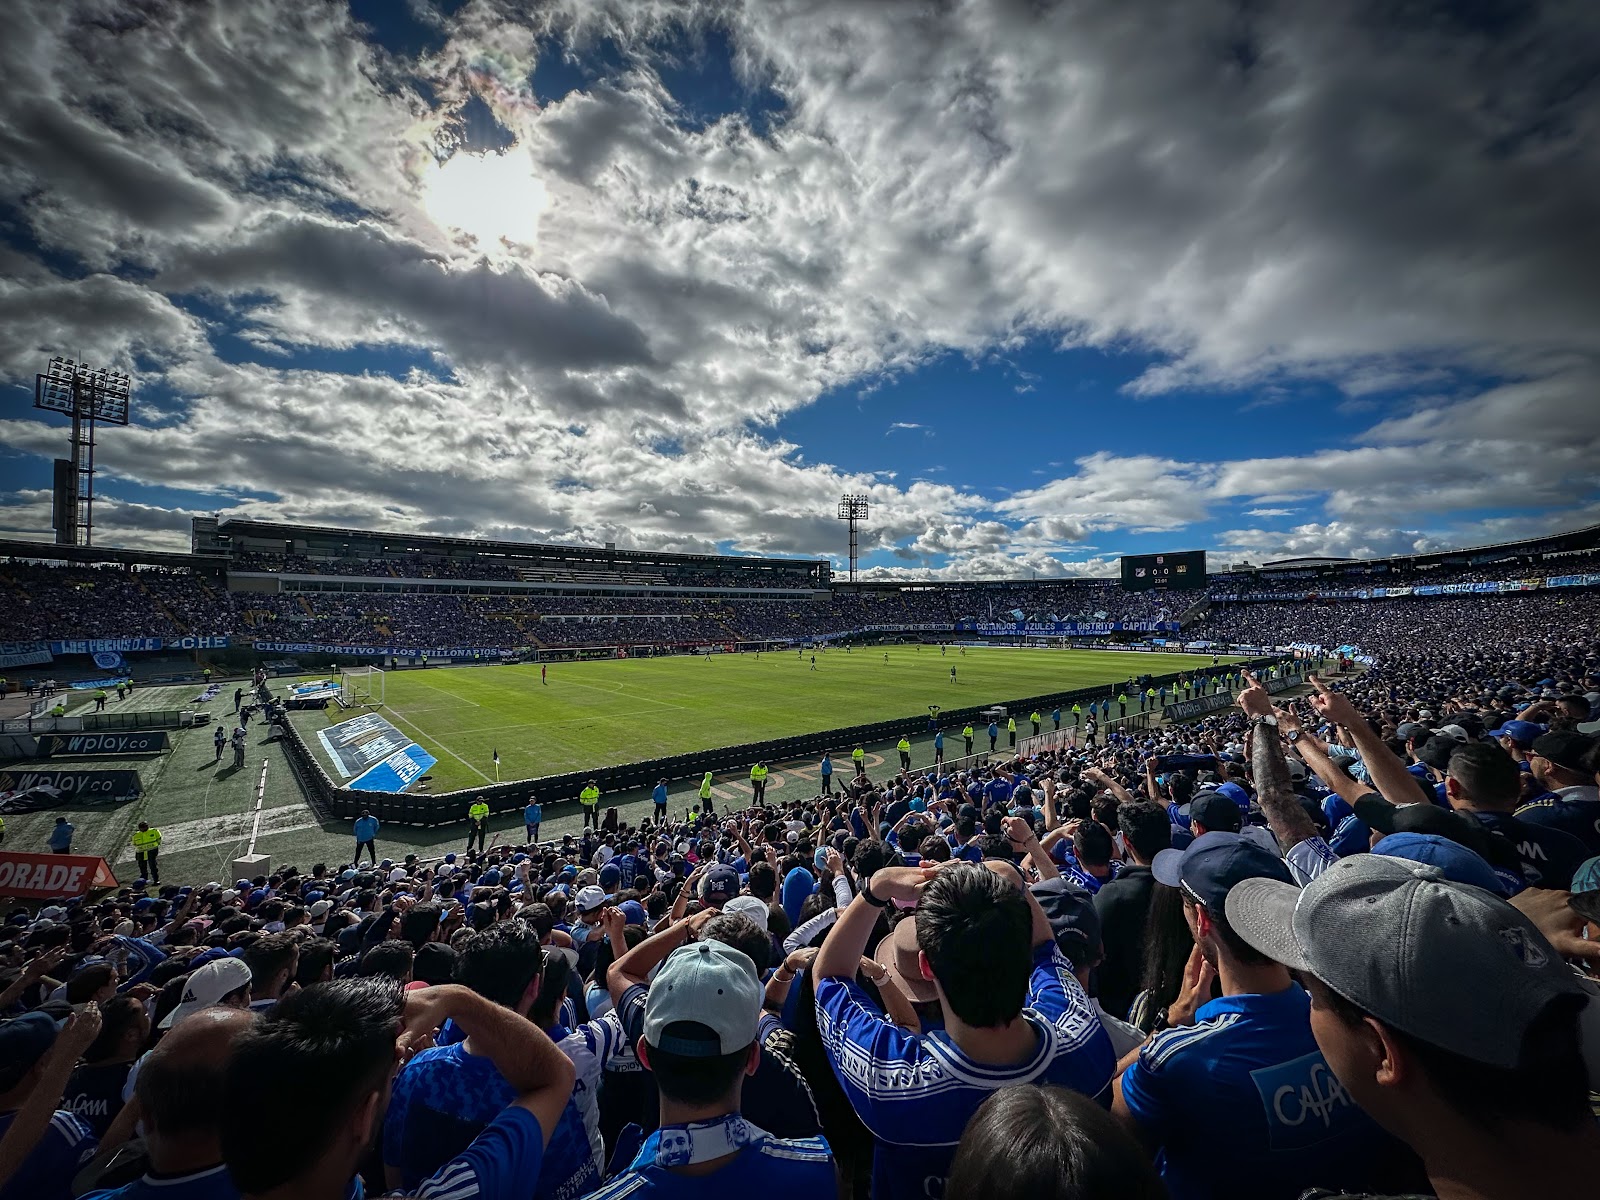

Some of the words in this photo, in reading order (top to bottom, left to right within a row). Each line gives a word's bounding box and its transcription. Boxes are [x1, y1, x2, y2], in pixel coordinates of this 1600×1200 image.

[1152, 568, 1158, 576] 0
[1163, 567, 1169, 575] 0
[1024, 622, 1056, 631] AZULES
[1077, 622, 1115, 630] DISTRITO
[1122, 622, 1158, 631] CAPITAL
[256, 642, 294, 652] CLUB
[393, 648, 416, 656] LOS
[420, 648, 497, 657] MILLONARIOS
[0, 861, 87, 892] ORADE
